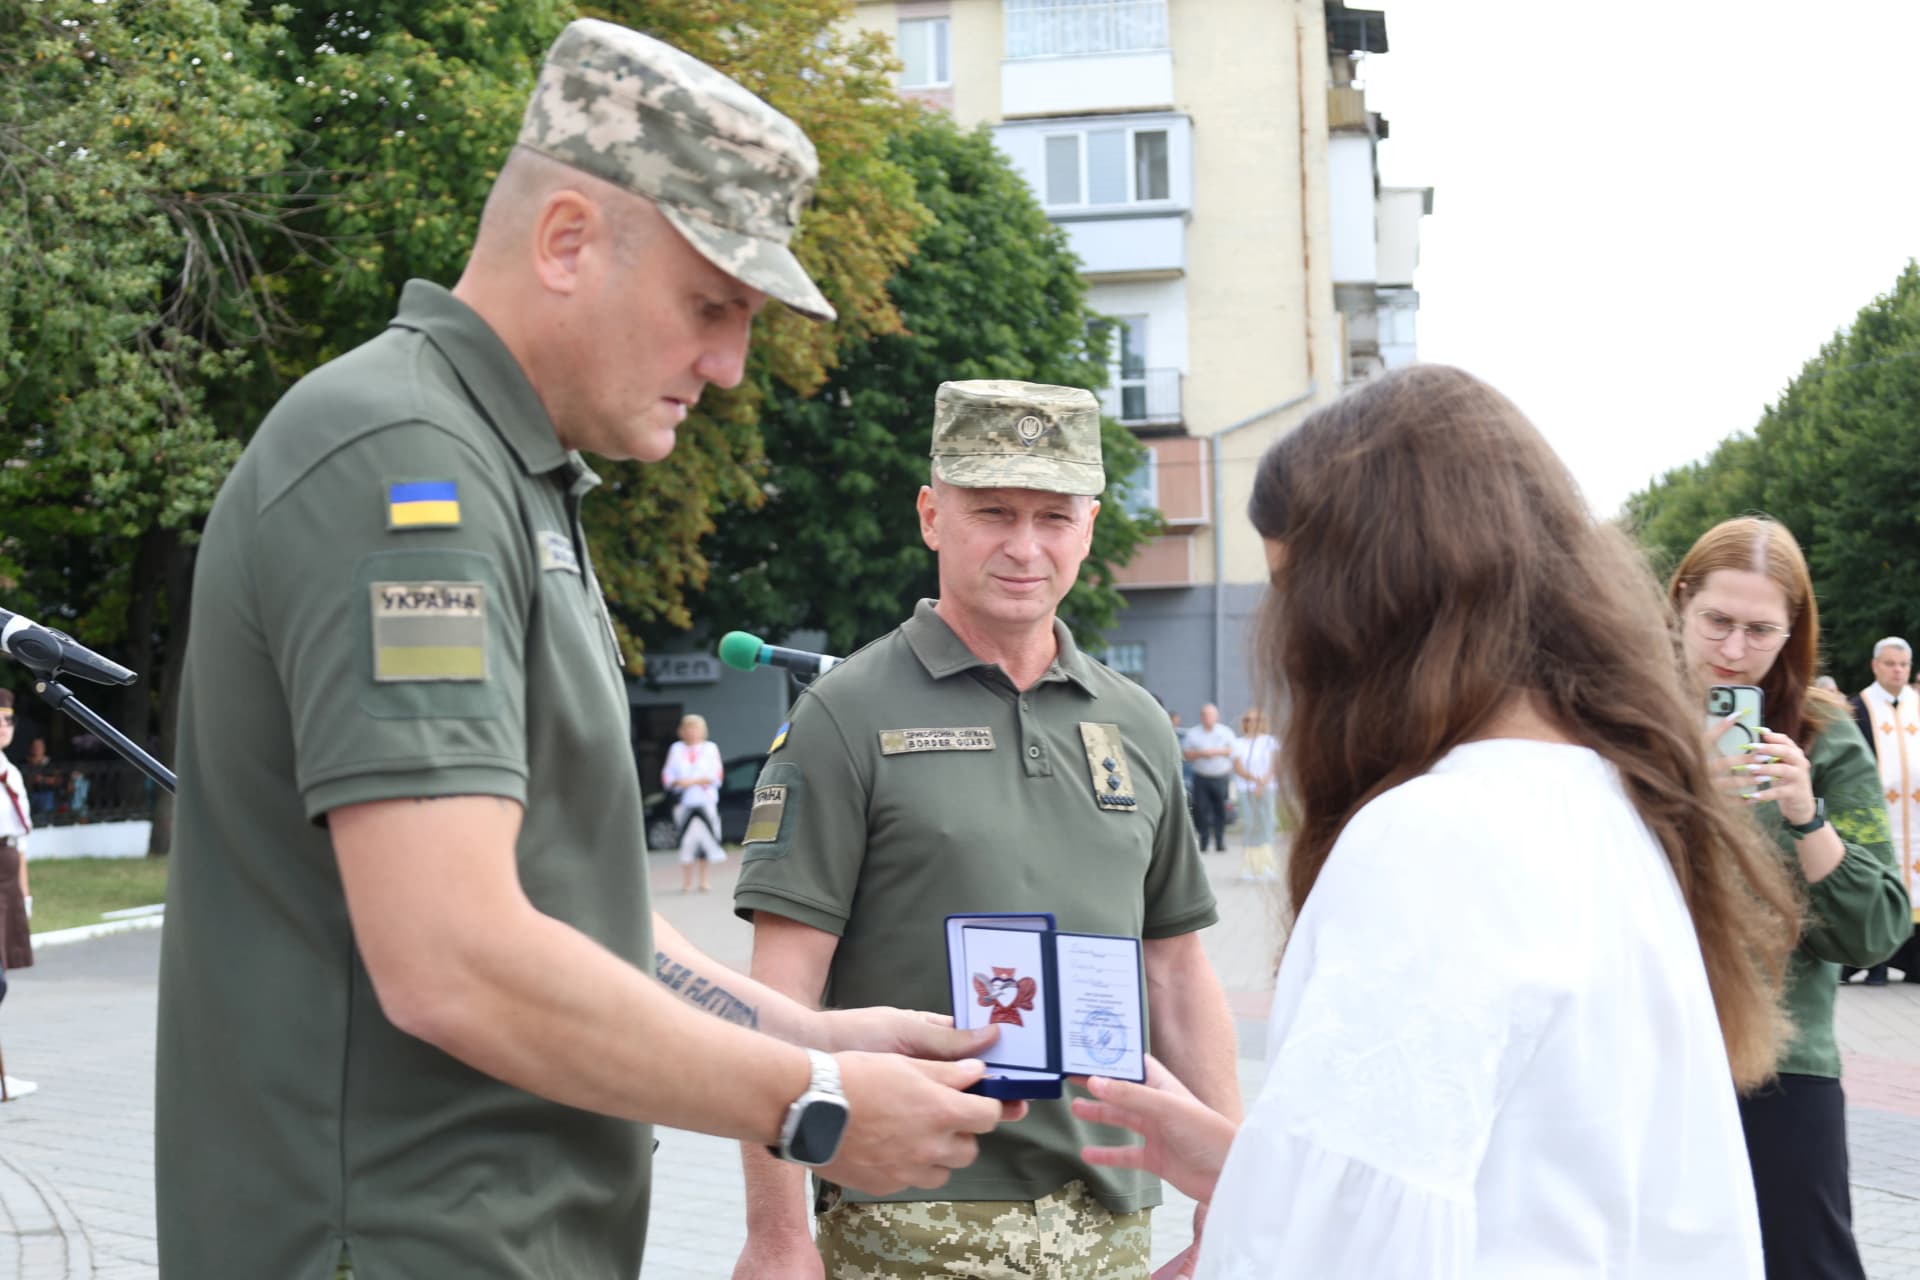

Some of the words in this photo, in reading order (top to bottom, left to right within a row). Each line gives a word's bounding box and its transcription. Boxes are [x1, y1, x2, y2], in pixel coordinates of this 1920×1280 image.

[381, 590, 476, 609] УКРАЇНА
[908, 739, 951, 748] BORDER
[957, 738, 990, 746] GUARD
